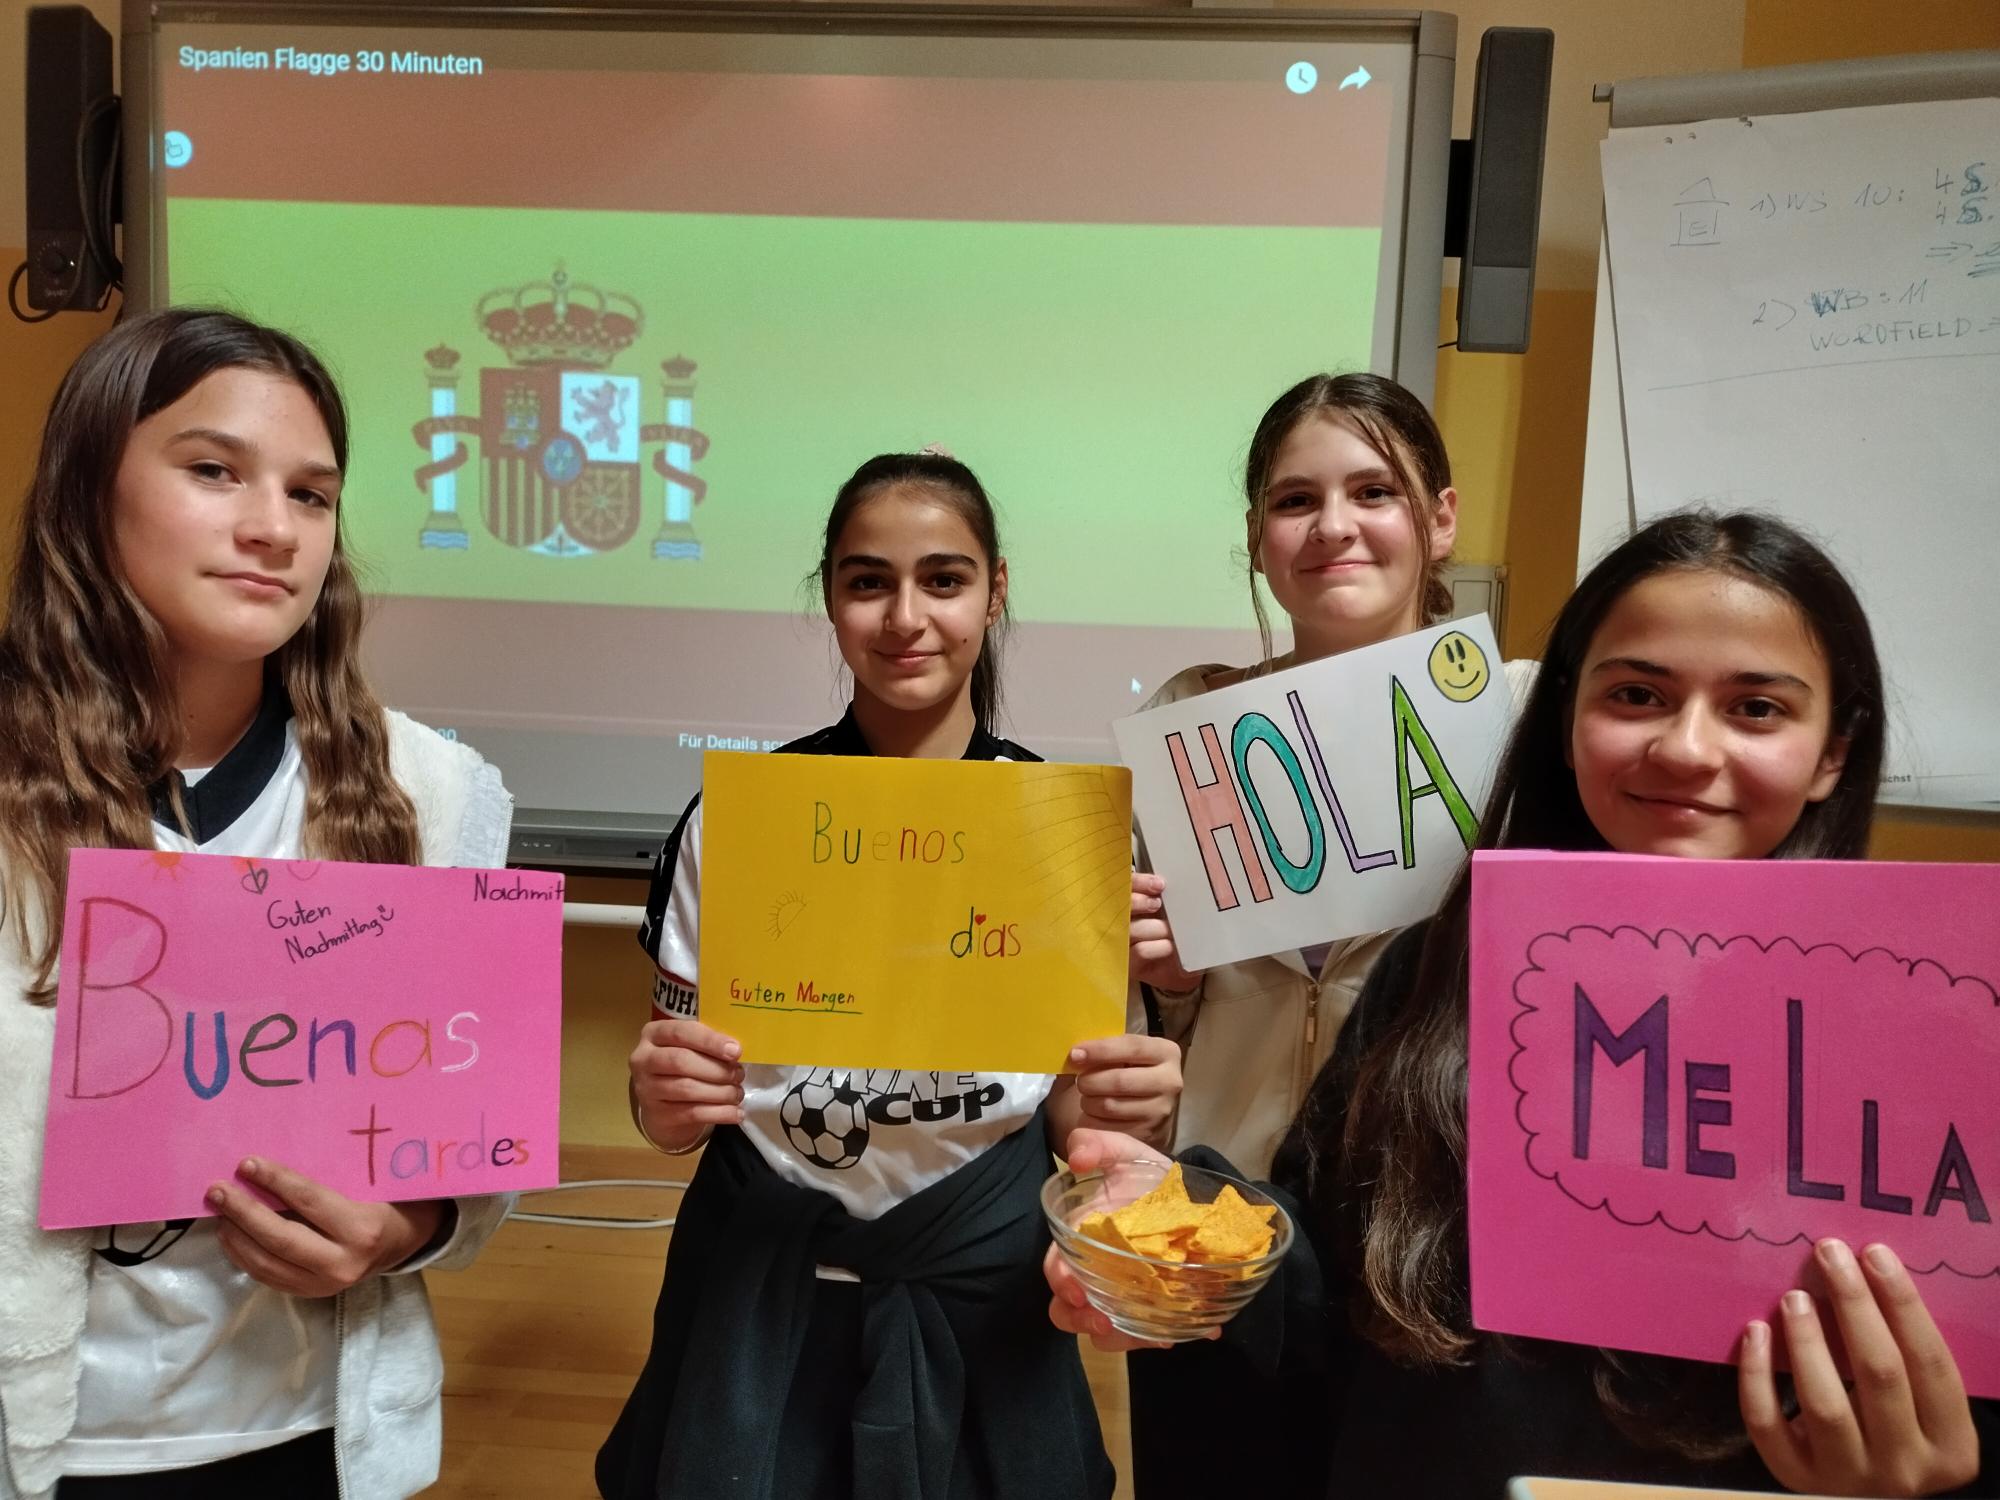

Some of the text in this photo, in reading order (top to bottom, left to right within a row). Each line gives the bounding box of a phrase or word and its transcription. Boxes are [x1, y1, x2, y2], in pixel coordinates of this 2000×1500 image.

[179, 46, 483, 75] Spanien Flagge 30 Minuten
[679, 732, 703, 749] Für
[707, 735, 758, 751] Details
[1165, 673, 1482, 912] HOLA
[812, 801, 967, 865] Buenos
[267, 900, 332, 929] Guten
[950, 906, 1022, 959] dias
[284, 918, 384, 964] Nachmittag
[64, 896, 481, 1100] Buenas
[730, 978, 855, 1012] Guten Morgen
[348, 1103, 530, 1187] tardes
